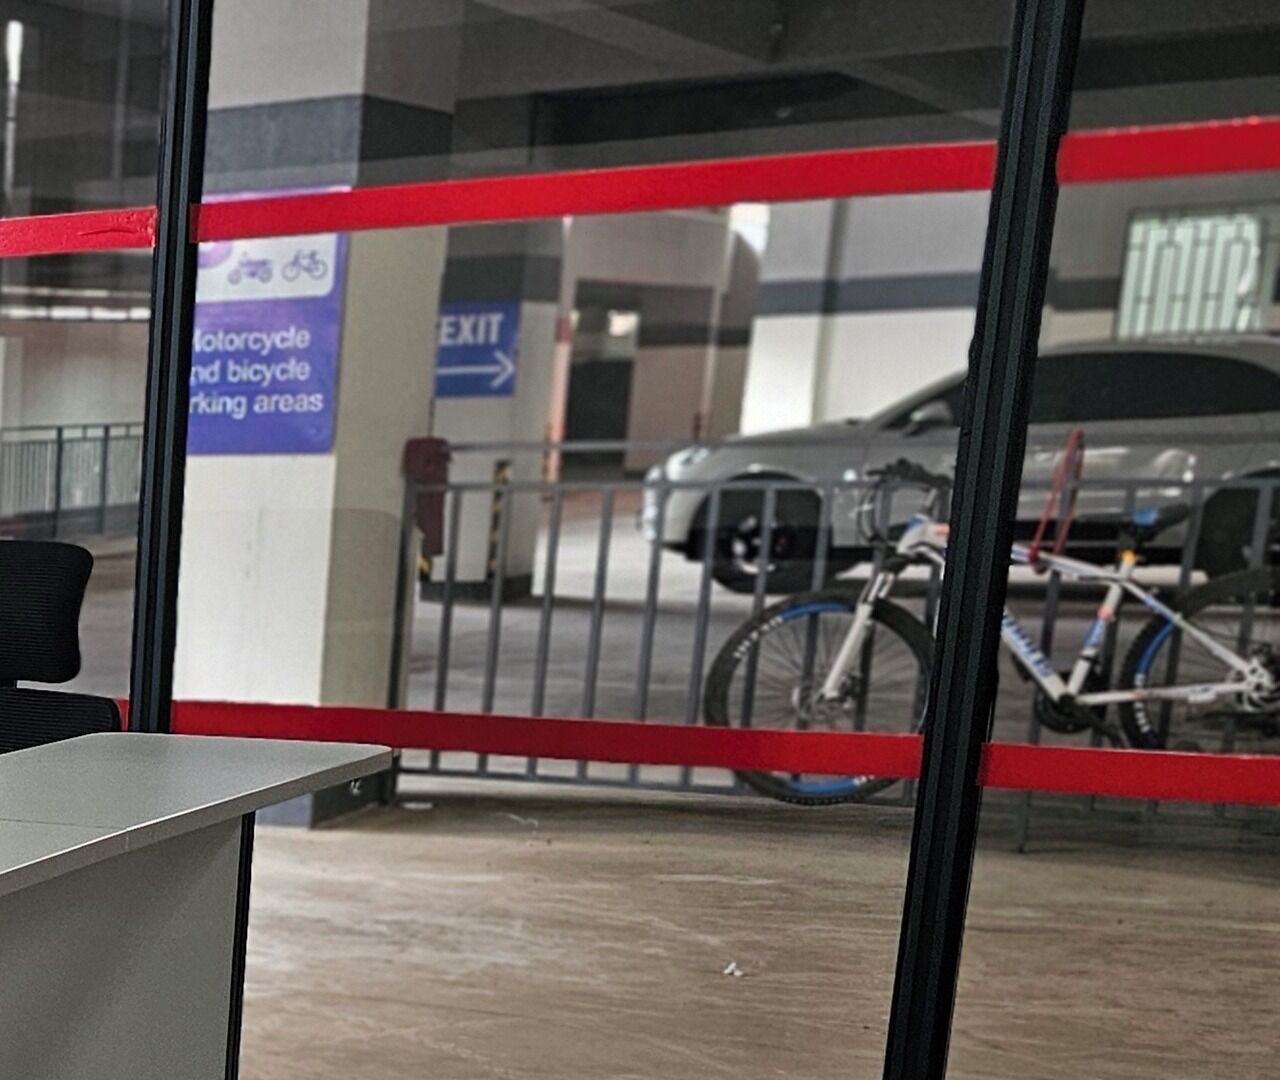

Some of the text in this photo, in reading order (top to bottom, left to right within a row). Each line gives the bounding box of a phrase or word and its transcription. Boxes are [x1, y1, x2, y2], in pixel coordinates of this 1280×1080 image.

[438, 313, 504, 345] EXIT
[191, 358, 311, 386] nd bicycle
[190, 391, 324, 419] rking areas
